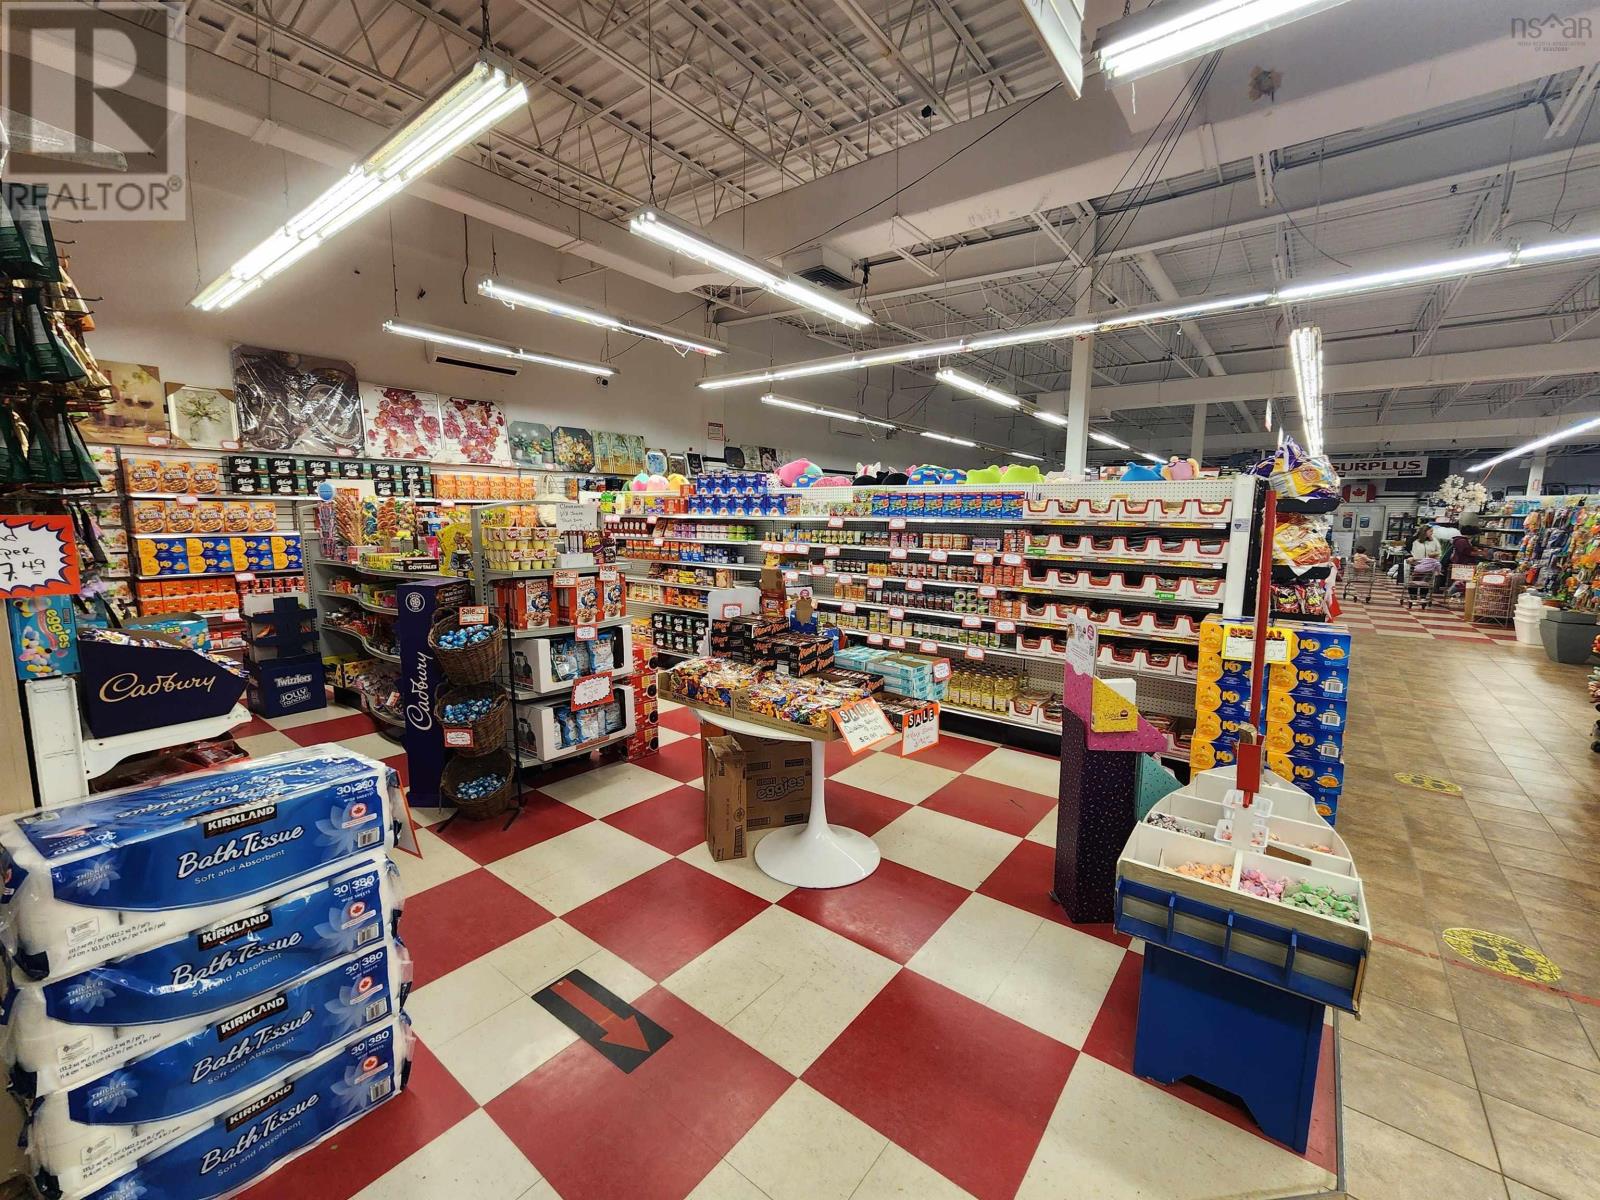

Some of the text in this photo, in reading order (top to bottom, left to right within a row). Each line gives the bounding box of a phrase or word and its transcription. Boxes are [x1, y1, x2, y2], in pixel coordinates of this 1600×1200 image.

[46, 609, 71, 649] eggies
[1230, 628, 1285, 640] SPEAL
[99, 672, 216, 702] Cadbury
[274, 674, 312, 687] Twizzlers
[281, 689, 306, 702] JOLLY
[406, 651, 433, 730] Cadbury
[839, 703, 874, 723] SALE
[908, 708, 934, 728] SALE
[757, 776, 804, 799] eggies
[207, 806, 275, 831] KIRKLAND
[178, 827, 304, 878] Bath Tissue
[194, 850, 285, 885] Soft and Absorbent
[333, 884, 349, 896] 30
[202, 913, 270, 943] KIRKLAND
[173, 932, 302, 987] Bath Tissue
[235, 953, 282, 977] Absorbent
[345, 951, 383, 975] 30 380
[220, 997, 285, 1034] KIRKLAND
[192, 1010, 313, 1083] Bath Tissue
[350, 1043, 365, 1056] 30
[229, 1084, 292, 1124] KIRKLAND
[200, 1126, 262, 1174] Bath
[261, 1094, 320, 1137] Tissue
[217, 1162, 238, 1176] Soft
[259, 1120, 302, 1150] Absorbent
